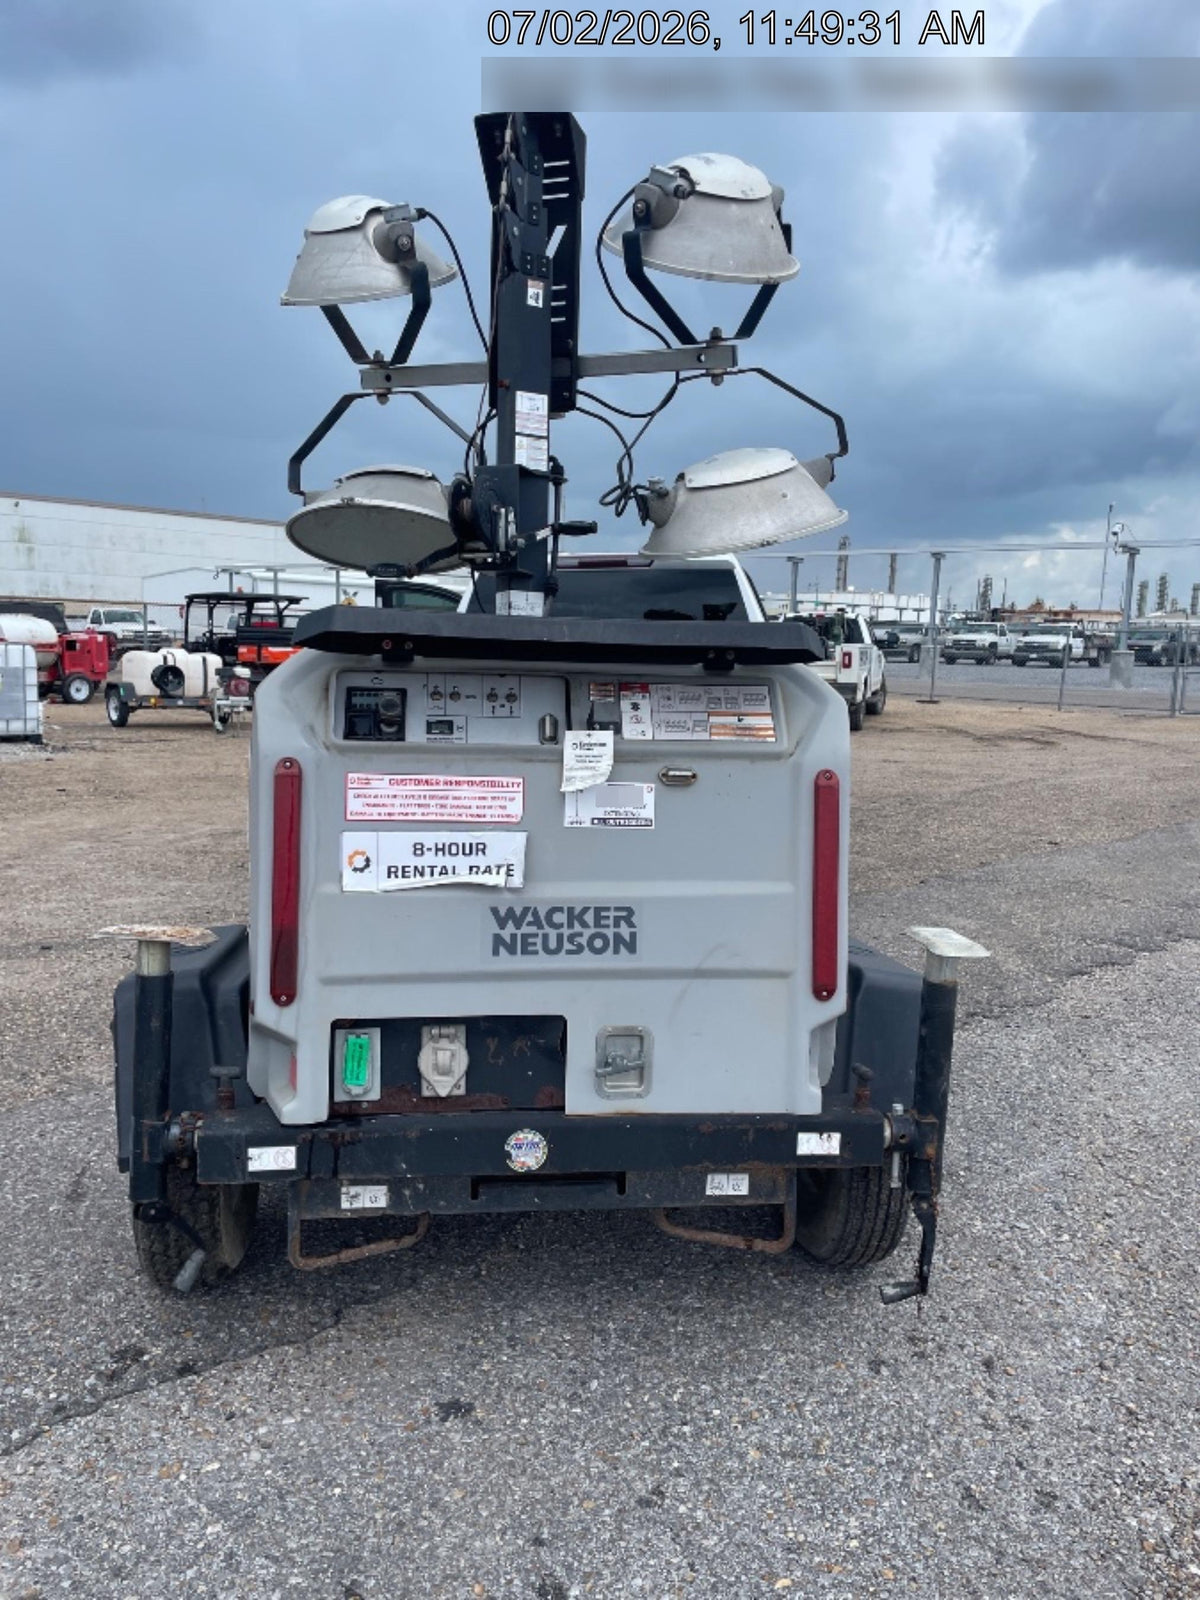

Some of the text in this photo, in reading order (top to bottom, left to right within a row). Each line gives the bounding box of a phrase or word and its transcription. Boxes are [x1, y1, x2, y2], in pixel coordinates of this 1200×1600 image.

[388, 778, 442, 787] CUSTOMER
[412, 842, 487, 857] 8-HOUR
[490, 906, 637, 930] WACKER
[492, 931, 637, 956] NEUSON
